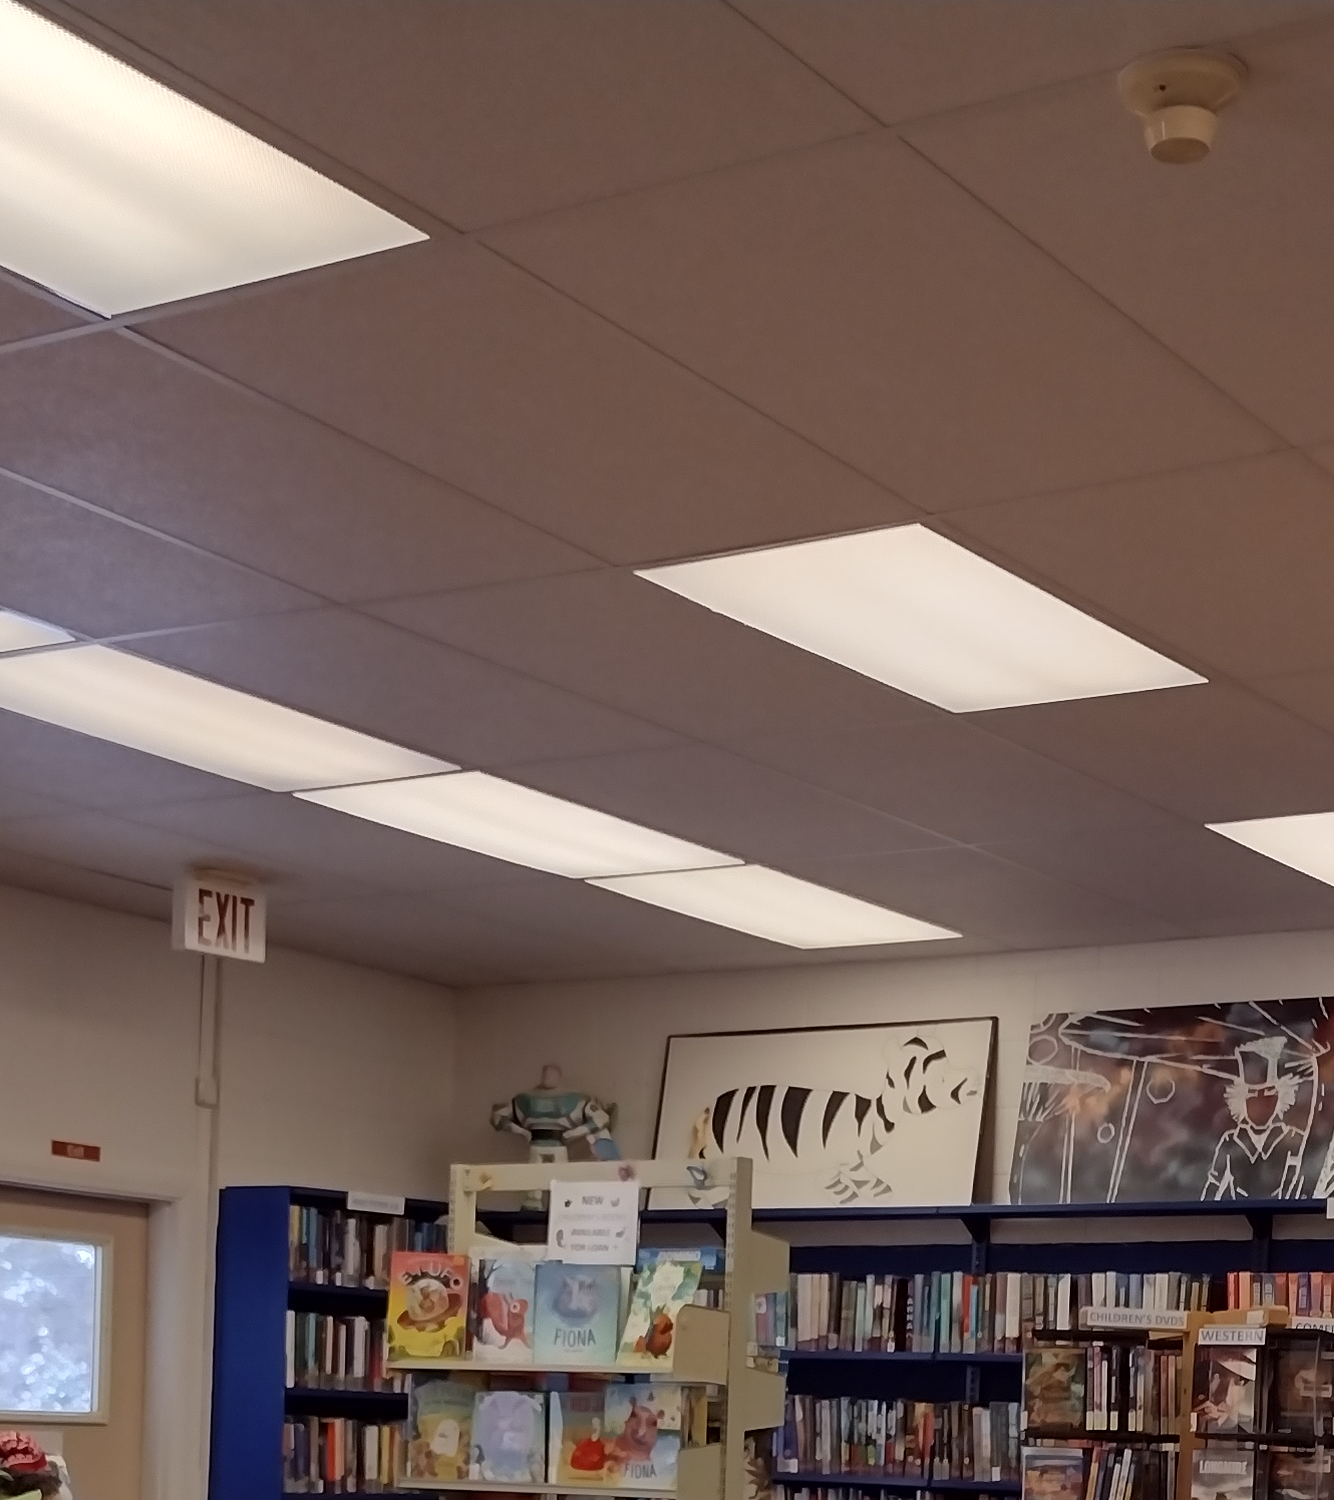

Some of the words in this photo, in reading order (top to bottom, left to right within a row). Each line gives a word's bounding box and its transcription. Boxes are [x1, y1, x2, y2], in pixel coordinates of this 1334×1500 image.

[198, 888, 255, 954] EXIT
[1089, 1312, 1152, 1326] CHILDREN'S
[1155, 1315, 1184, 1328] DVDS
[554, 1328, 597, 1349] FIONA
[1201, 1329, 1265, 1343] WESTERN
[624, 1463, 657, 1480] FIONA
